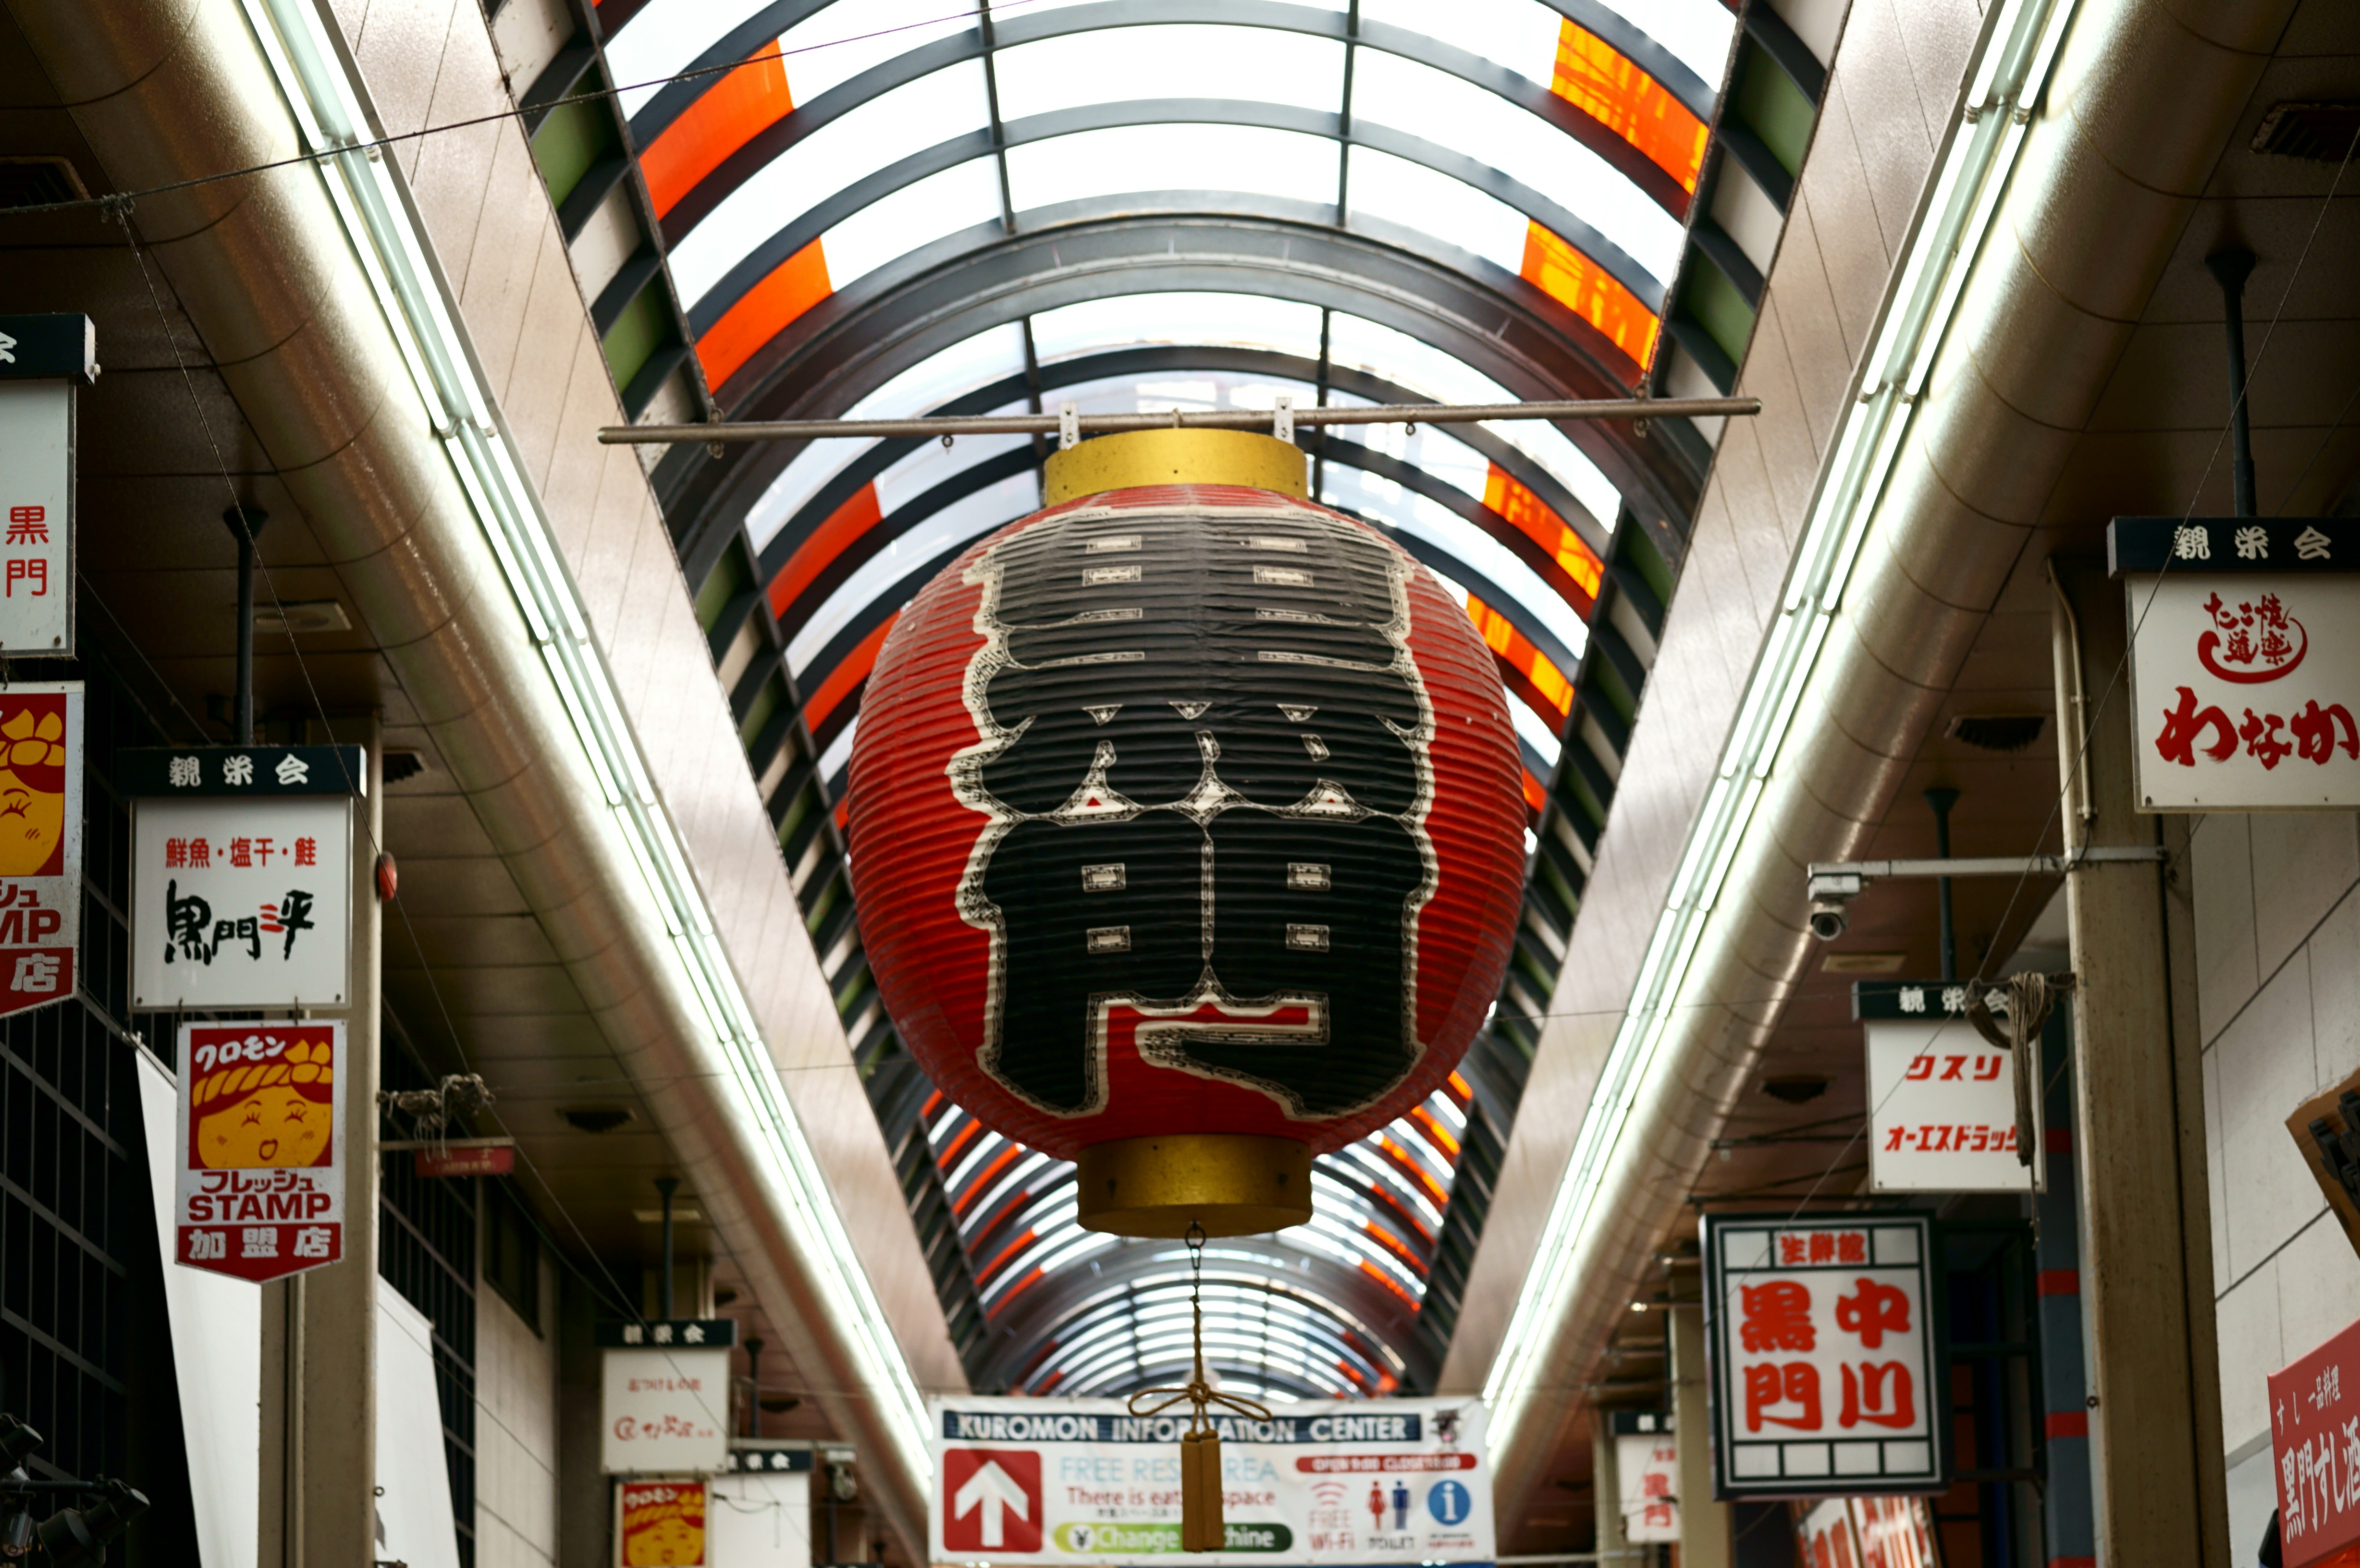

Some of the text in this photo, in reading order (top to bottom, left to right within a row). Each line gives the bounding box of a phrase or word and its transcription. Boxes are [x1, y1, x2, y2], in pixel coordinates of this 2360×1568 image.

[6, 505, 49, 598] 黒門
[2174, 525, 2332, 560] 親栄会
[2155, 686, 2360, 771] わなか
[169, 754, 309, 787] 親栄会
[165, 836, 317, 869] 鮮魚・塩干・鮭
[164, 879, 315, 967] 黒門三平
[10, 953, 61, 993] 店
[195, 1035, 286, 1072] クロモン
[1905, 1055, 2003, 1081] クスリ
[201, 1169, 315, 1194] フレッシュ
[188, 1193, 331, 1222] STAMP
[188, 1226, 332, 1260] 加盟店
[1740, 1280, 1824, 1433] 黒門
[1835, 1277, 1916, 1430] 中川
[957, 1415, 1098, 1440] KUROMON
[1308, 1417, 1406, 1440] CENTER
[1060, 1457, 1279, 1482] FREE RES REA
[1068, 1487, 1124, 1506] There
[1129, 1488, 1144, 1505] is
[1151, 1491, 1182, 1506] eat
[1096, 1525, 1276, 1552] Change hine
